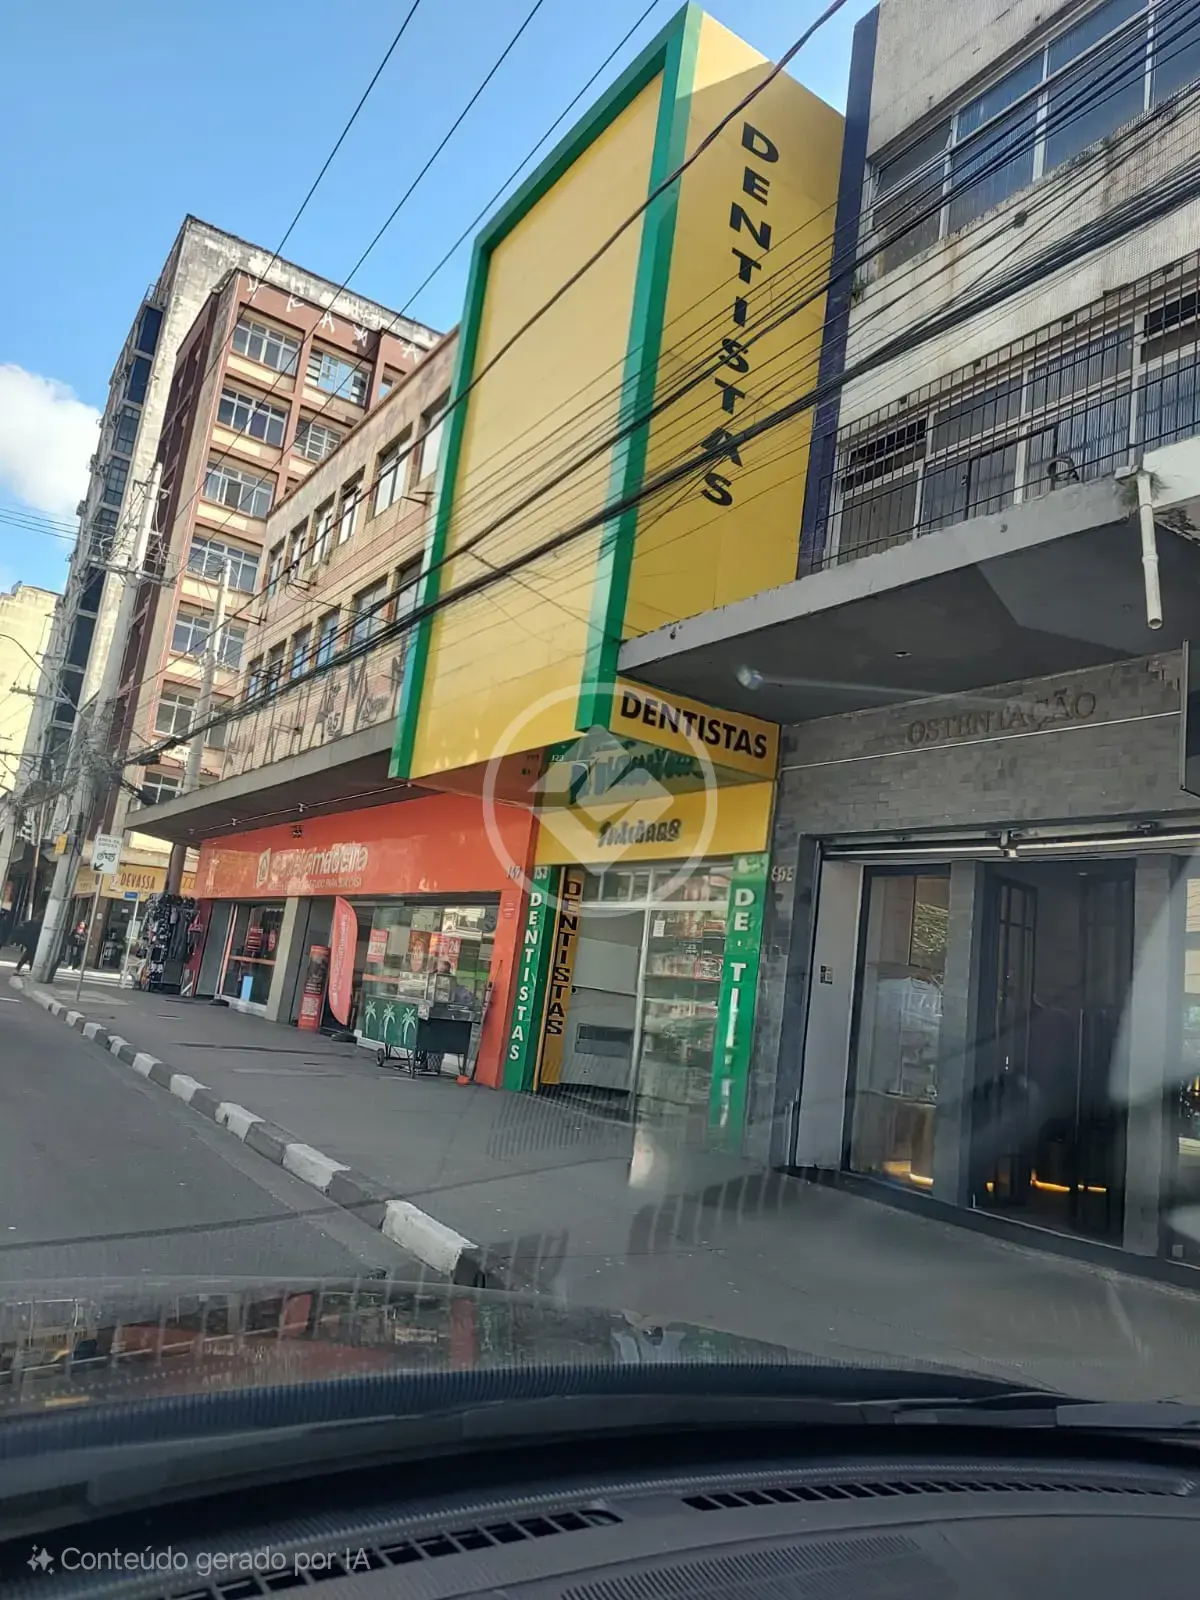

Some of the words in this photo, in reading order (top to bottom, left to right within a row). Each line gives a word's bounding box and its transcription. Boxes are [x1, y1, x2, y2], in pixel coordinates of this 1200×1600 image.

[700, 121, 779, 507] DENTISTAS
[620, 690, 767, 759] DENTISTAS
[907, 687, 1096, 745] OSTENTAÇÃO
[120, 873, 156, 889] DEVASSA
[509, 892, 542, 1060] DENTISTAS
[545, 881, 582, 1035] DENTISTAS
